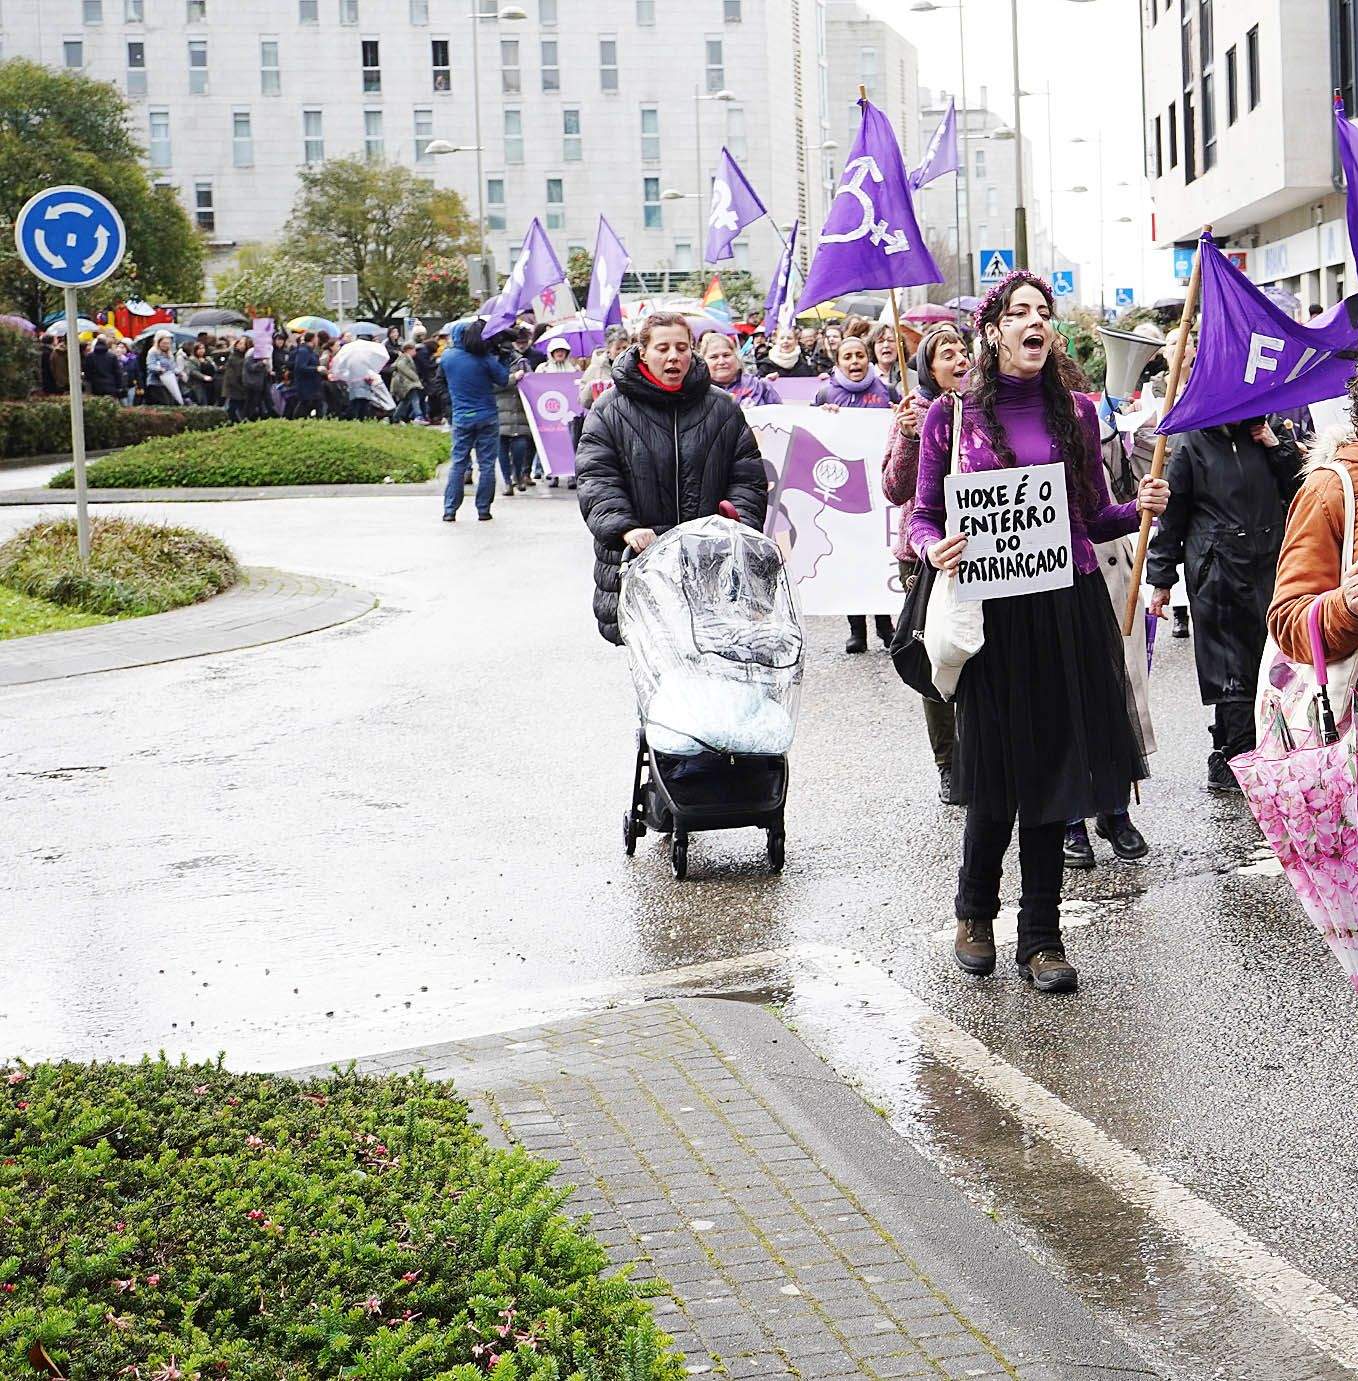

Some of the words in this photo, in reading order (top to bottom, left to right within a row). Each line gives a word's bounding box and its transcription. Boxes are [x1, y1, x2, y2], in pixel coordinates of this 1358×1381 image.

[956, 485, 1010, 510] HOXE
[1014, 474, 1030, 505] É
[1039, 481, 1052, 501] O
[959, 506, 1056, 537] ENTERRO
[995, 535, 1021, 553] DO
[958, 546, 1068, 584] PATRIARCADO
